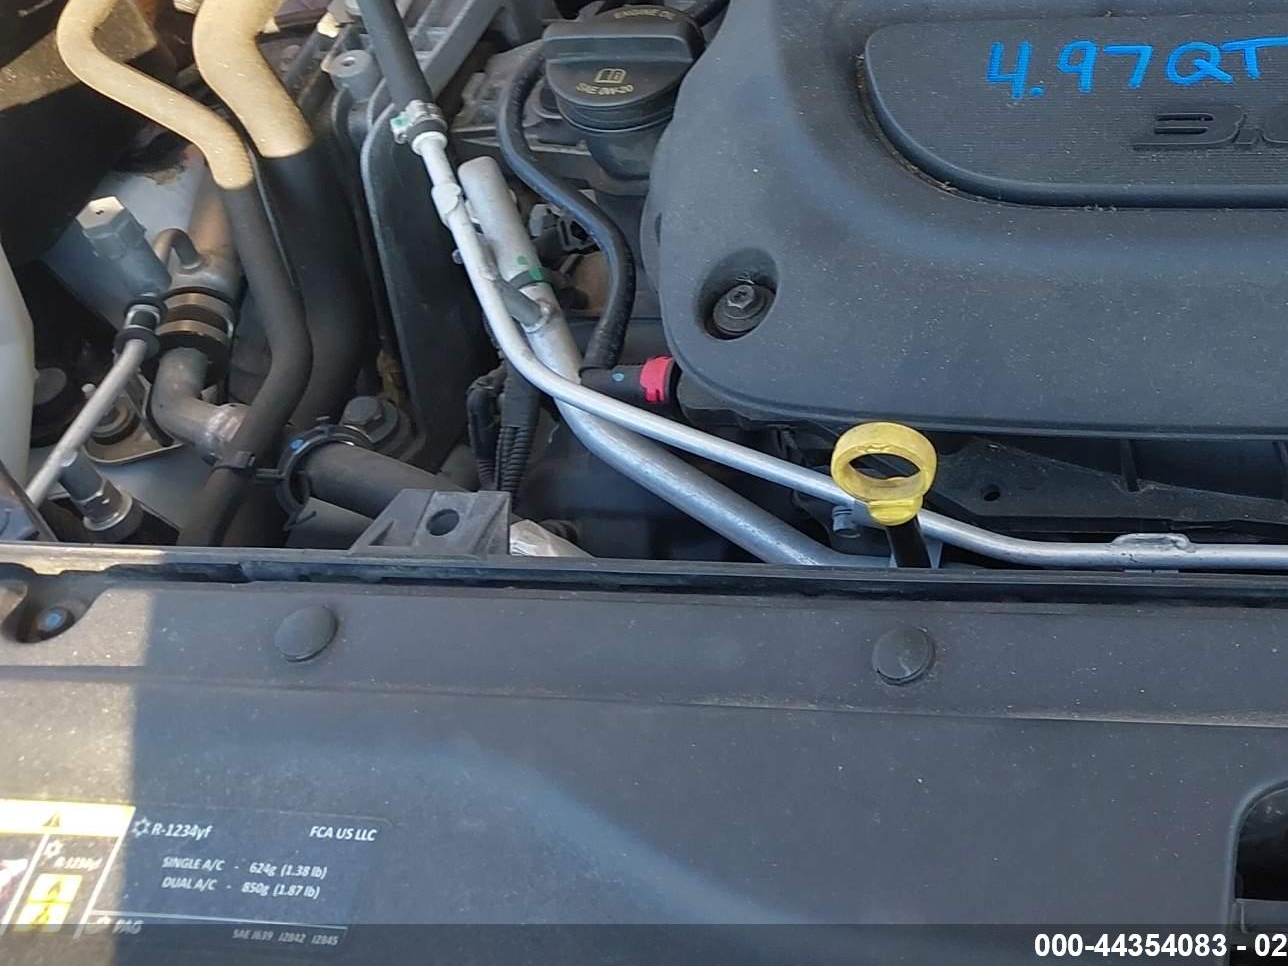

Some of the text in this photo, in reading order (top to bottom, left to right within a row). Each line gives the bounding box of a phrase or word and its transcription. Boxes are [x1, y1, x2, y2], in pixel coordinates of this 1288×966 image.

[151, 822, 214, 841] R-1234yf
[309, 825, 378, 842] FCA US LLC
[162, 856, 201, 870] SINGLE
[201, 859, 226, 871] A/C
[249, 862, 278, 878] 624g
[280, 864, 312, 878] (1.38
[311, 866, 328, 880] lb)
[162, 876, 193, 889] DUAL
[193, 878, 219, 892] A/C
[241, 882, 271, 897] 850g
[273, 883, 303, 898] (1.87
[303, 886, 321, 900] lb)
